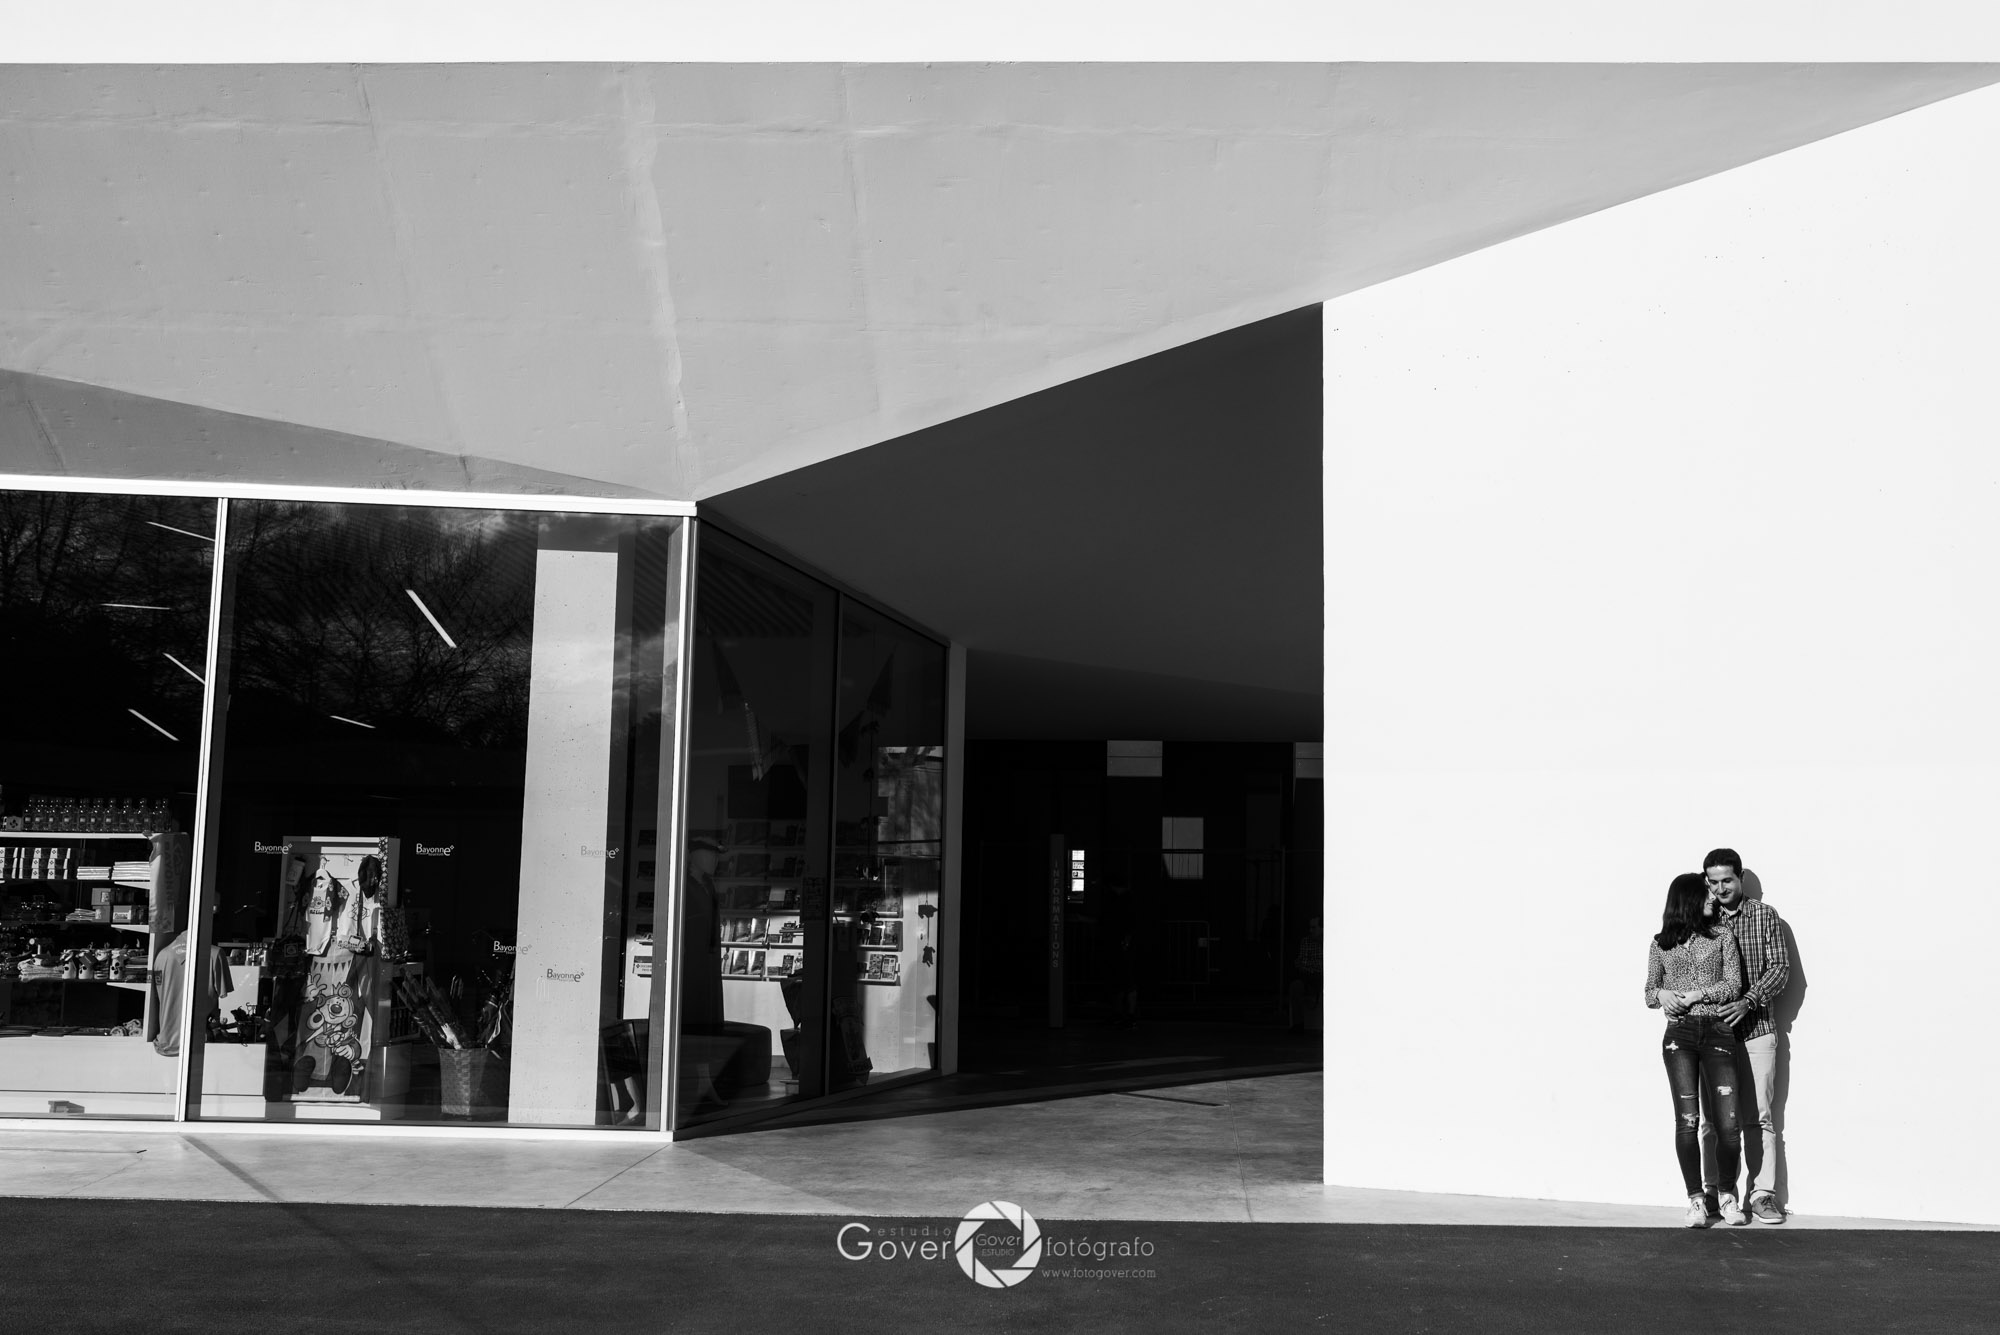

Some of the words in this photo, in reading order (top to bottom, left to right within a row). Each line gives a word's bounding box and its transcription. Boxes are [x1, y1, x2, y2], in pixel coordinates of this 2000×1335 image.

[255, 841, 290, 855] Bayonne
[416, 843, 452, 857] Bayonne
[581, 845, 616, 859] Bayonne
[1052, 861, 1060, 968] INFORMATIONS
[494, 940, 529, 955] Bayonne
[546, 968, 582, 982] Bayonne
